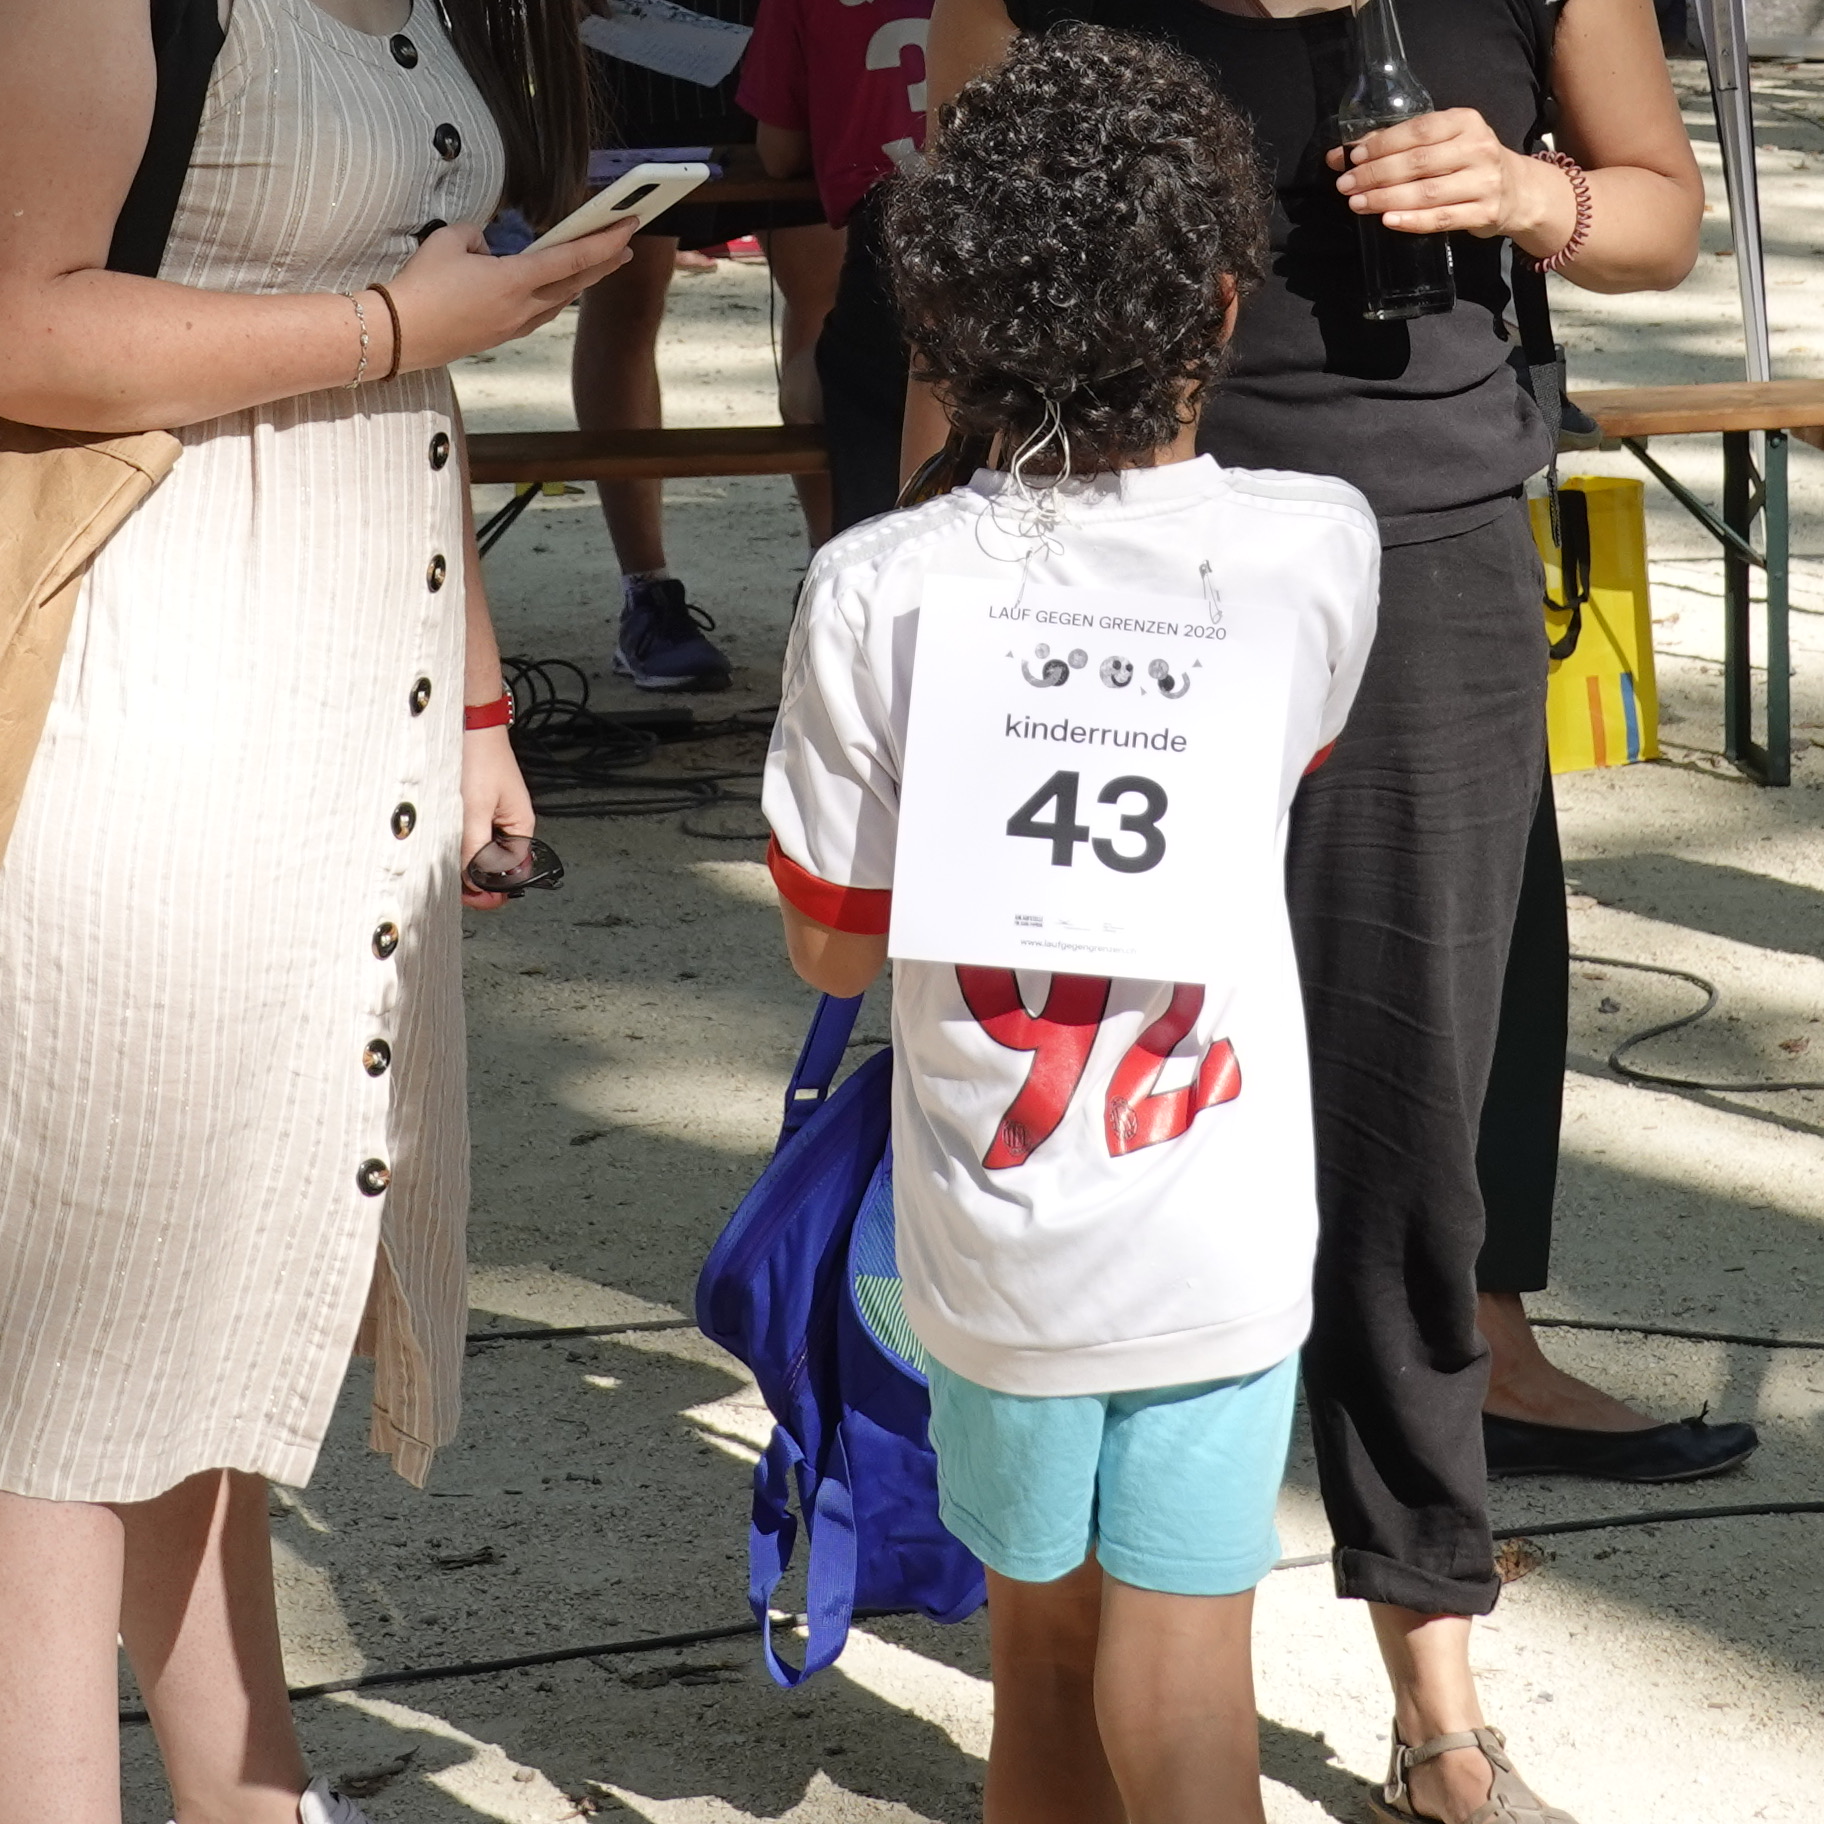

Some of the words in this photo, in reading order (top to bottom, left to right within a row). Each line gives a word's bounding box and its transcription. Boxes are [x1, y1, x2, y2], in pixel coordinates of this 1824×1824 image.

[988, 605, 1032, 622] LAUF
[1035, 610, 1094, 628] GEGEN
[1098, 615, 1179, 636] GRENZEN
[1183, 623, 1227, 641] 2020
[1005, 713, 1188, 753] kinderrunde
[1006, 768, 1169, 874] 43
